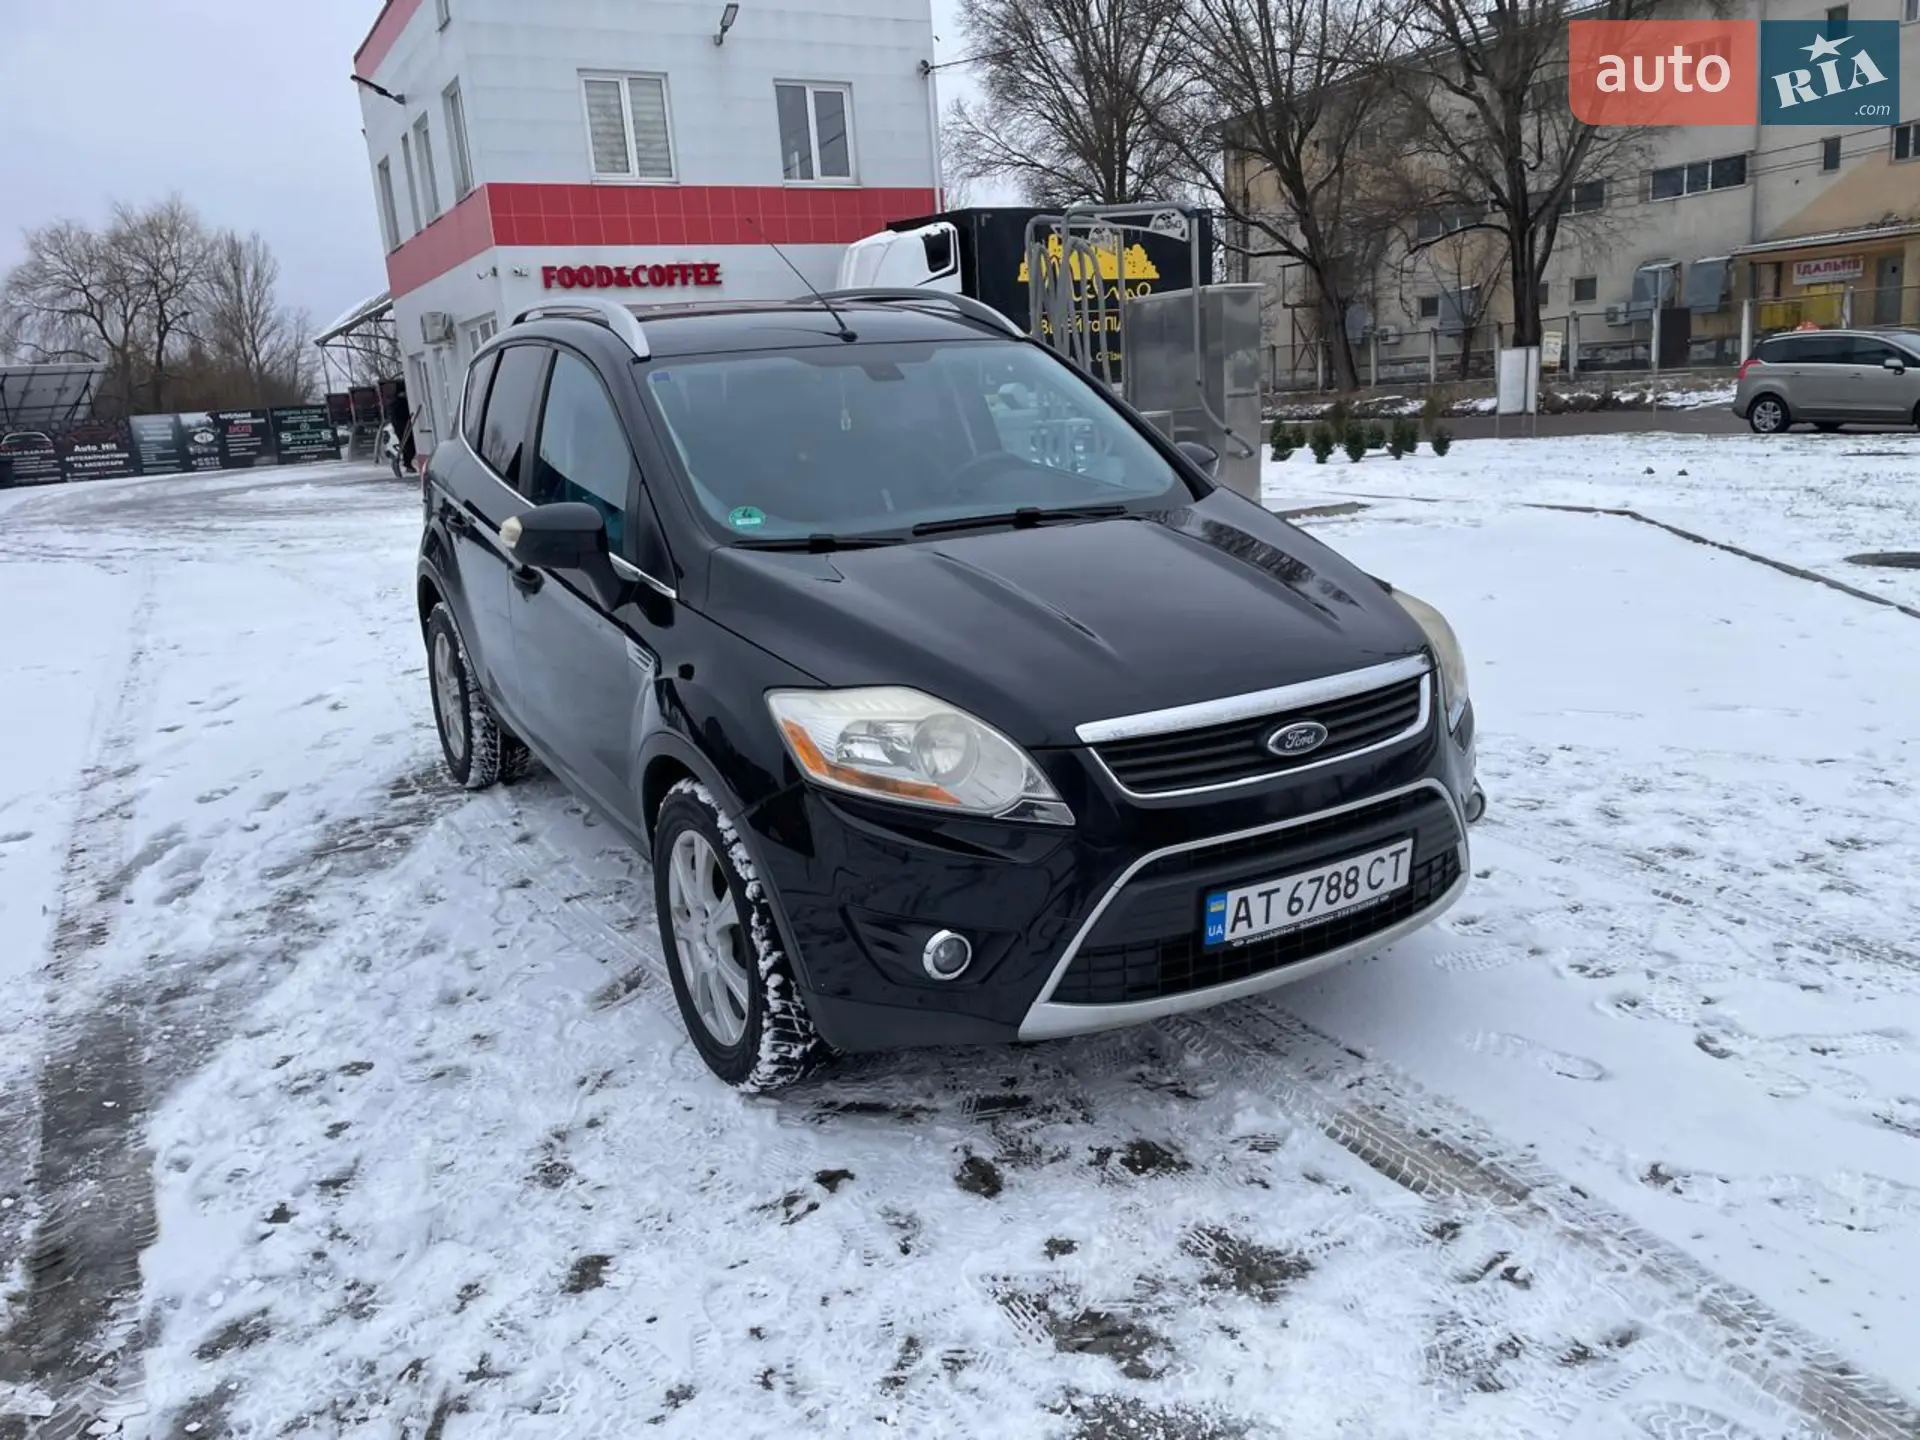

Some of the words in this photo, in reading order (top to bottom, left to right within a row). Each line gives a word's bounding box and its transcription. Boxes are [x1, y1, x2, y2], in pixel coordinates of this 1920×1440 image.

[541, 263, 723, 289] FOOD&COFFEE
[1284, 728, 1316, 749] Ford
[1229, 887, 1281, 934] AT
[1286, 866, 1360, 918] 6788
[1366, 847, 1408, 891] CT
[1208, 924, 1224, 937] UA
